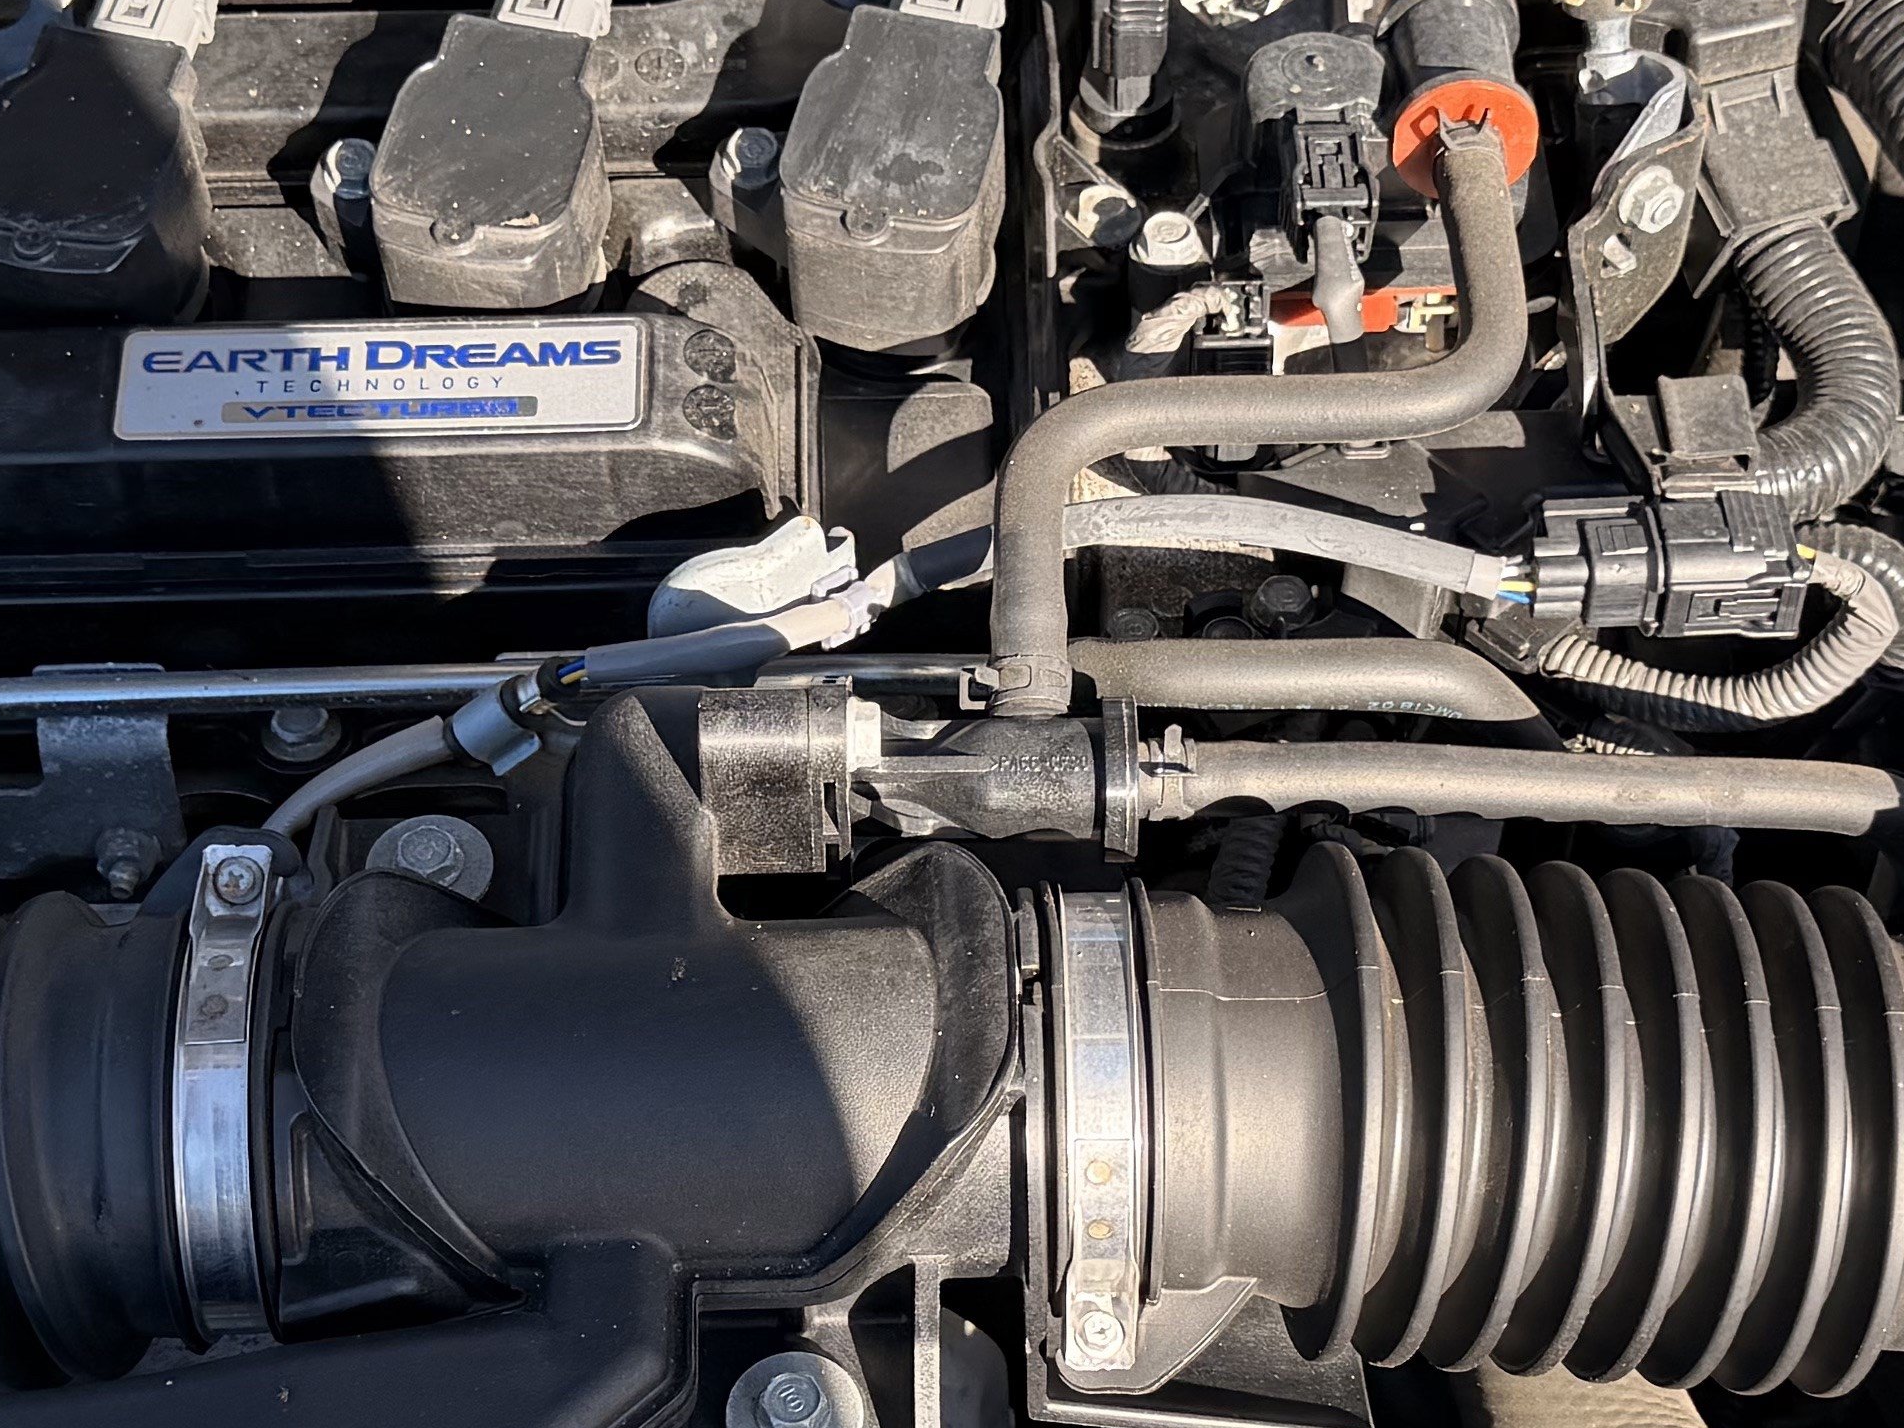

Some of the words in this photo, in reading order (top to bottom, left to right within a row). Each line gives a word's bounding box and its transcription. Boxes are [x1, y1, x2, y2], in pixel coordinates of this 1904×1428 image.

[142, 345, 354, 373] EARTH
[364, 339, 624, 370] DREAMS
[254, 376, 505, 395] TECHNOLOGY
[242, 403, 366, 420] VTEC
[372, 397, 521, 418] TURBO
